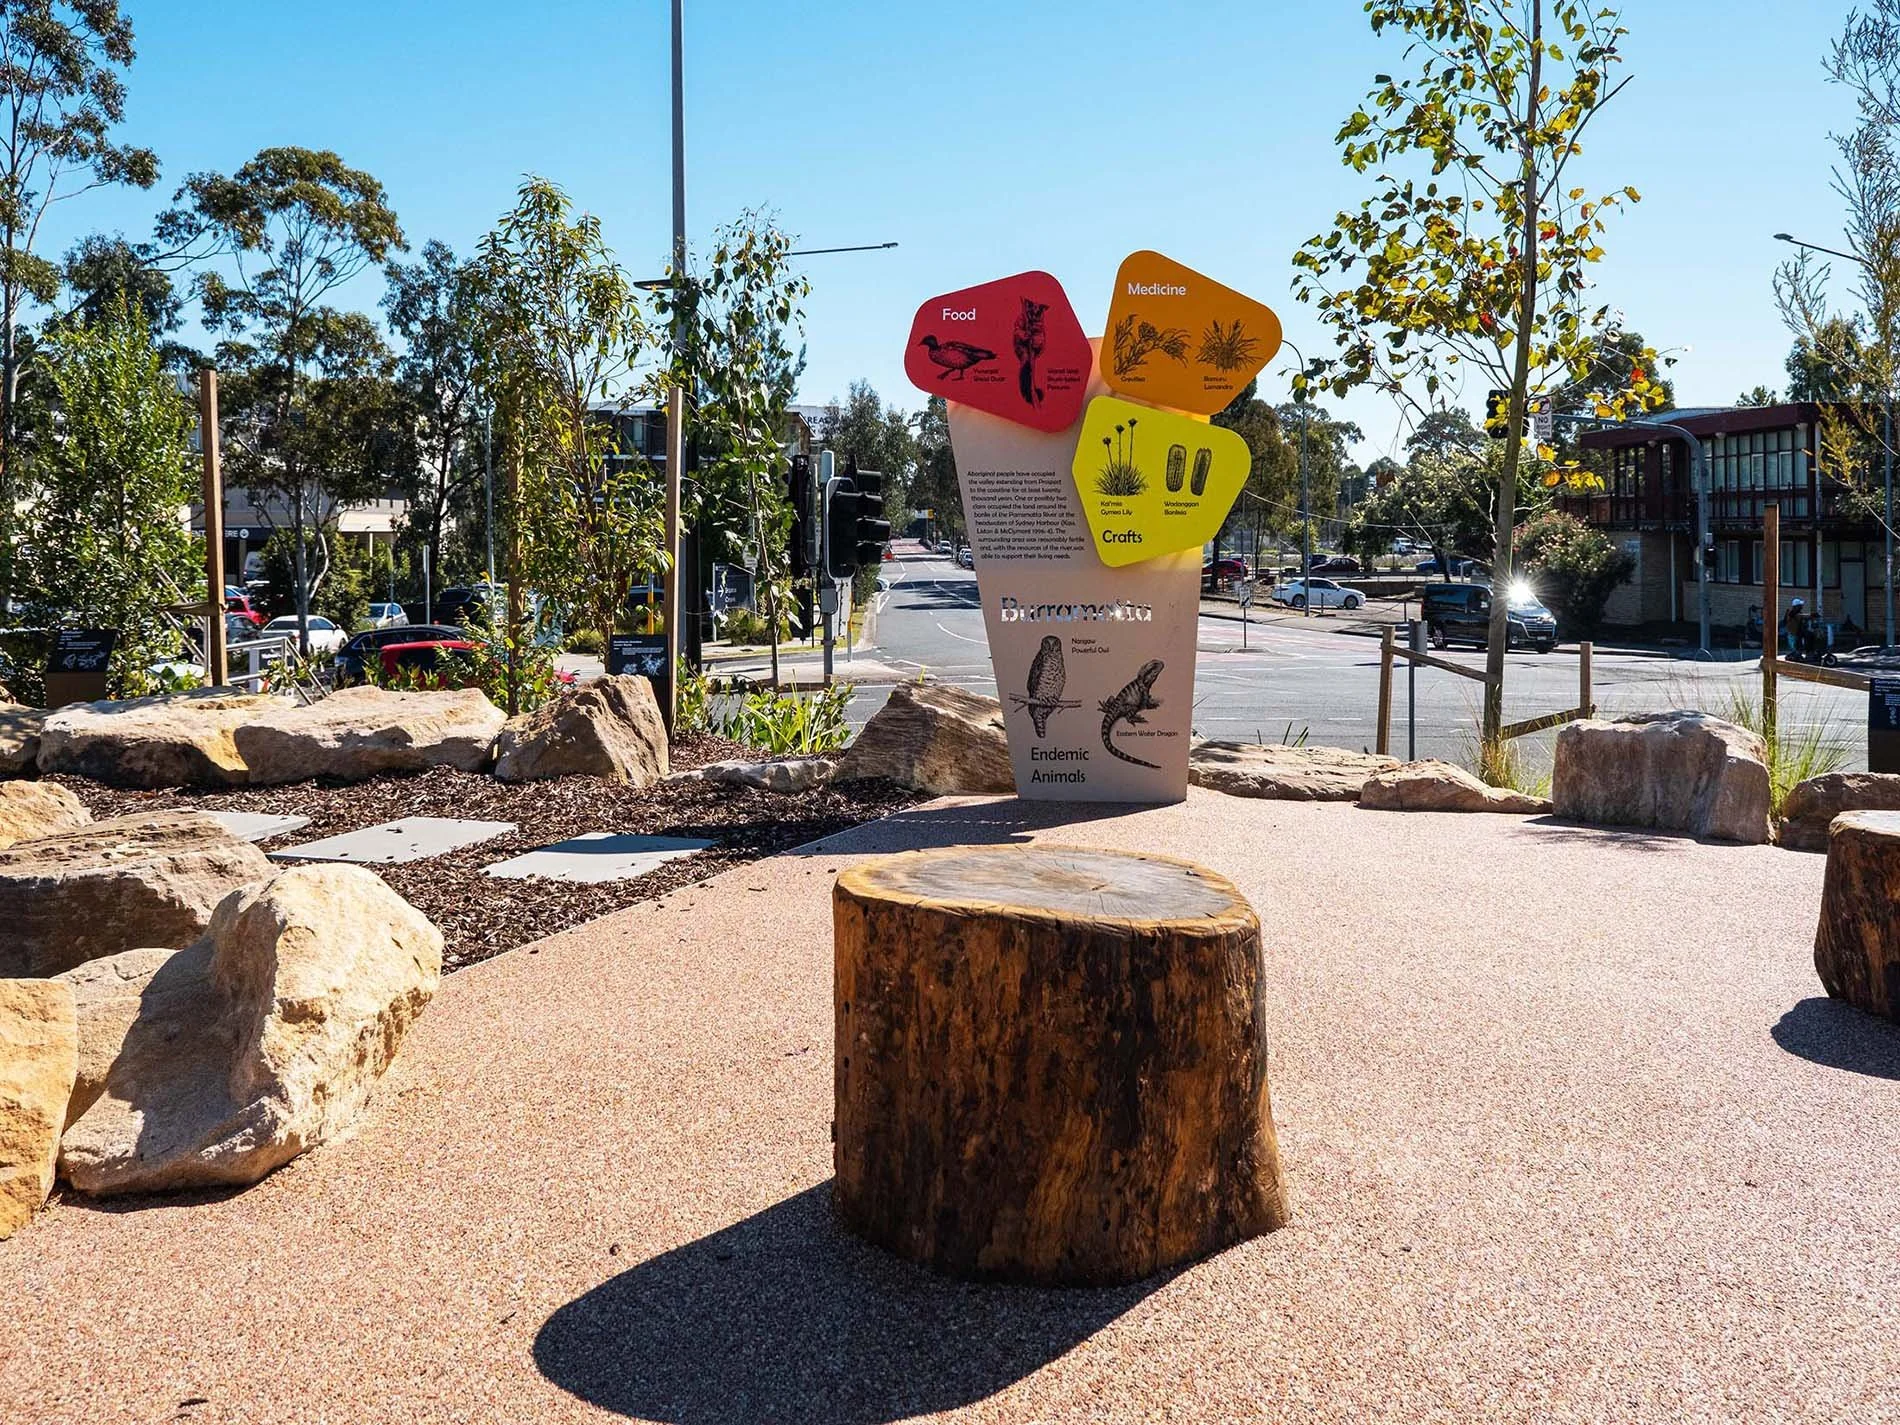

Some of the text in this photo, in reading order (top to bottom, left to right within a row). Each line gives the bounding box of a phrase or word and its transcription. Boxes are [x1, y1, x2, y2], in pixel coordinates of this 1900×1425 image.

[1127, 282, 1187, 296] Medicine
[942, 307, 976, 321] Food
[1537, 416, 1548, 424] NO
[1102, 530, 1143, 543] Crafts
[1156, 730, 1178, 738] Dragon
[1031, 747, 1089, 761] Endemic
[1031, 769, 1086, 784] Animals
